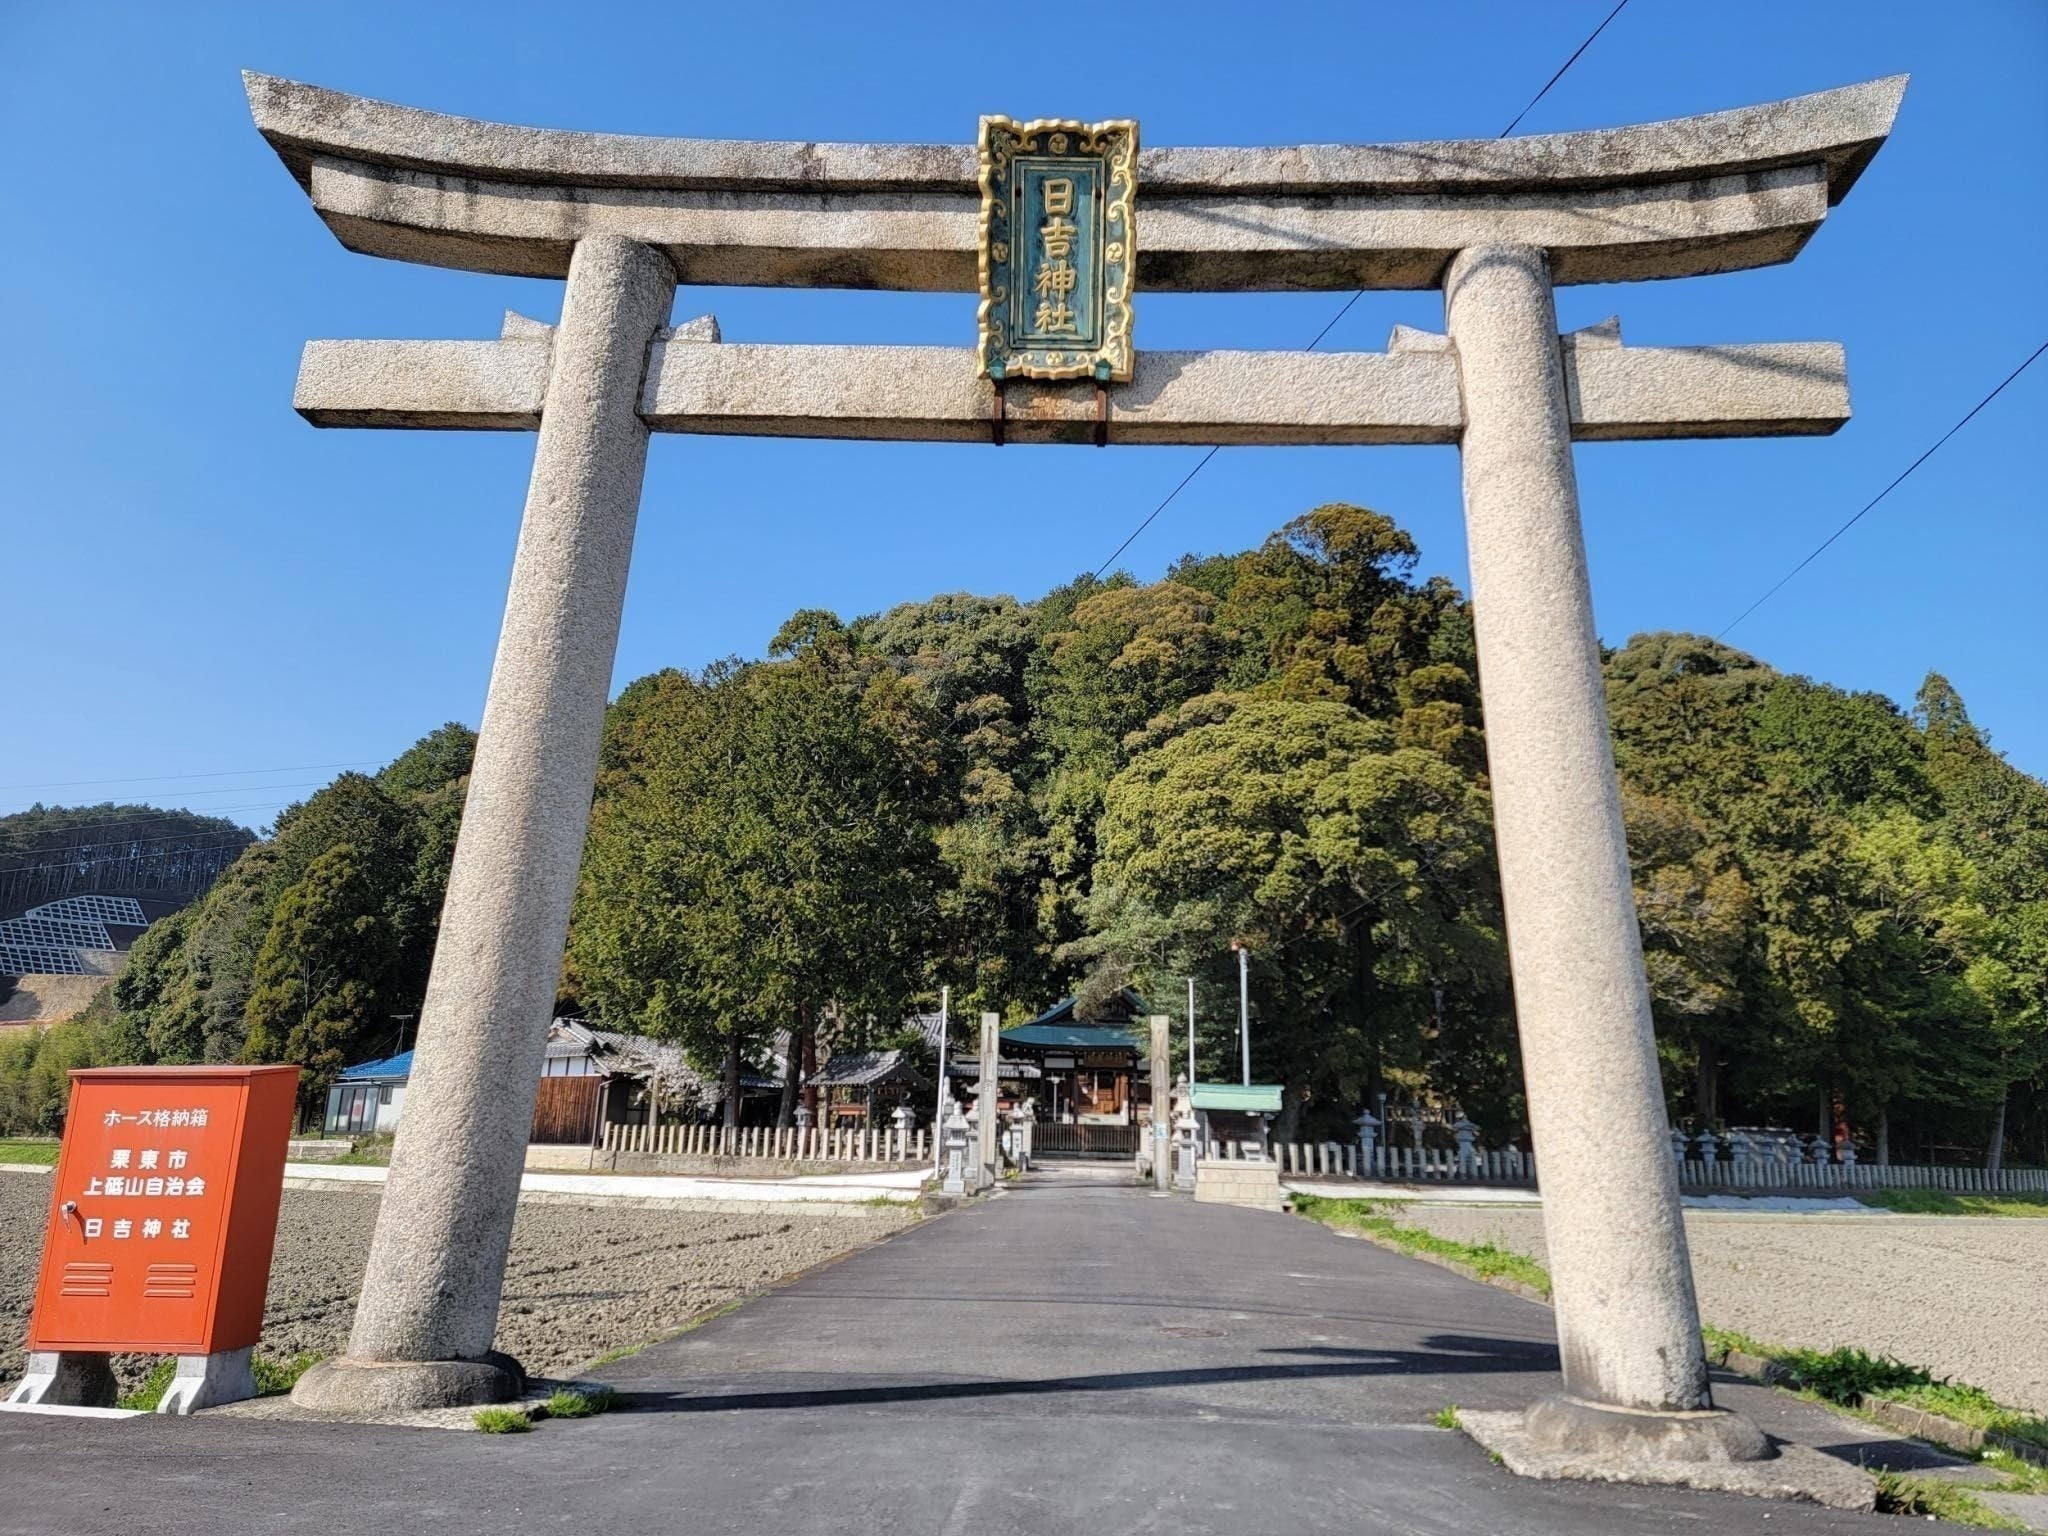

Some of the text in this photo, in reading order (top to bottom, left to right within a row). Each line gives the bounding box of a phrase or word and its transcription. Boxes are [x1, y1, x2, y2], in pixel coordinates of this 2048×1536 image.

[1035, 178, 1077, 334] 日吉神社
[103, 1108, 208, 1128] ホース格納箱
[110, 1149, 188, 1169] 栗東市
[83, 1176, 206, 1196] 上砥山自治会
[85, 1218, 191, 1239] 日吉神社
